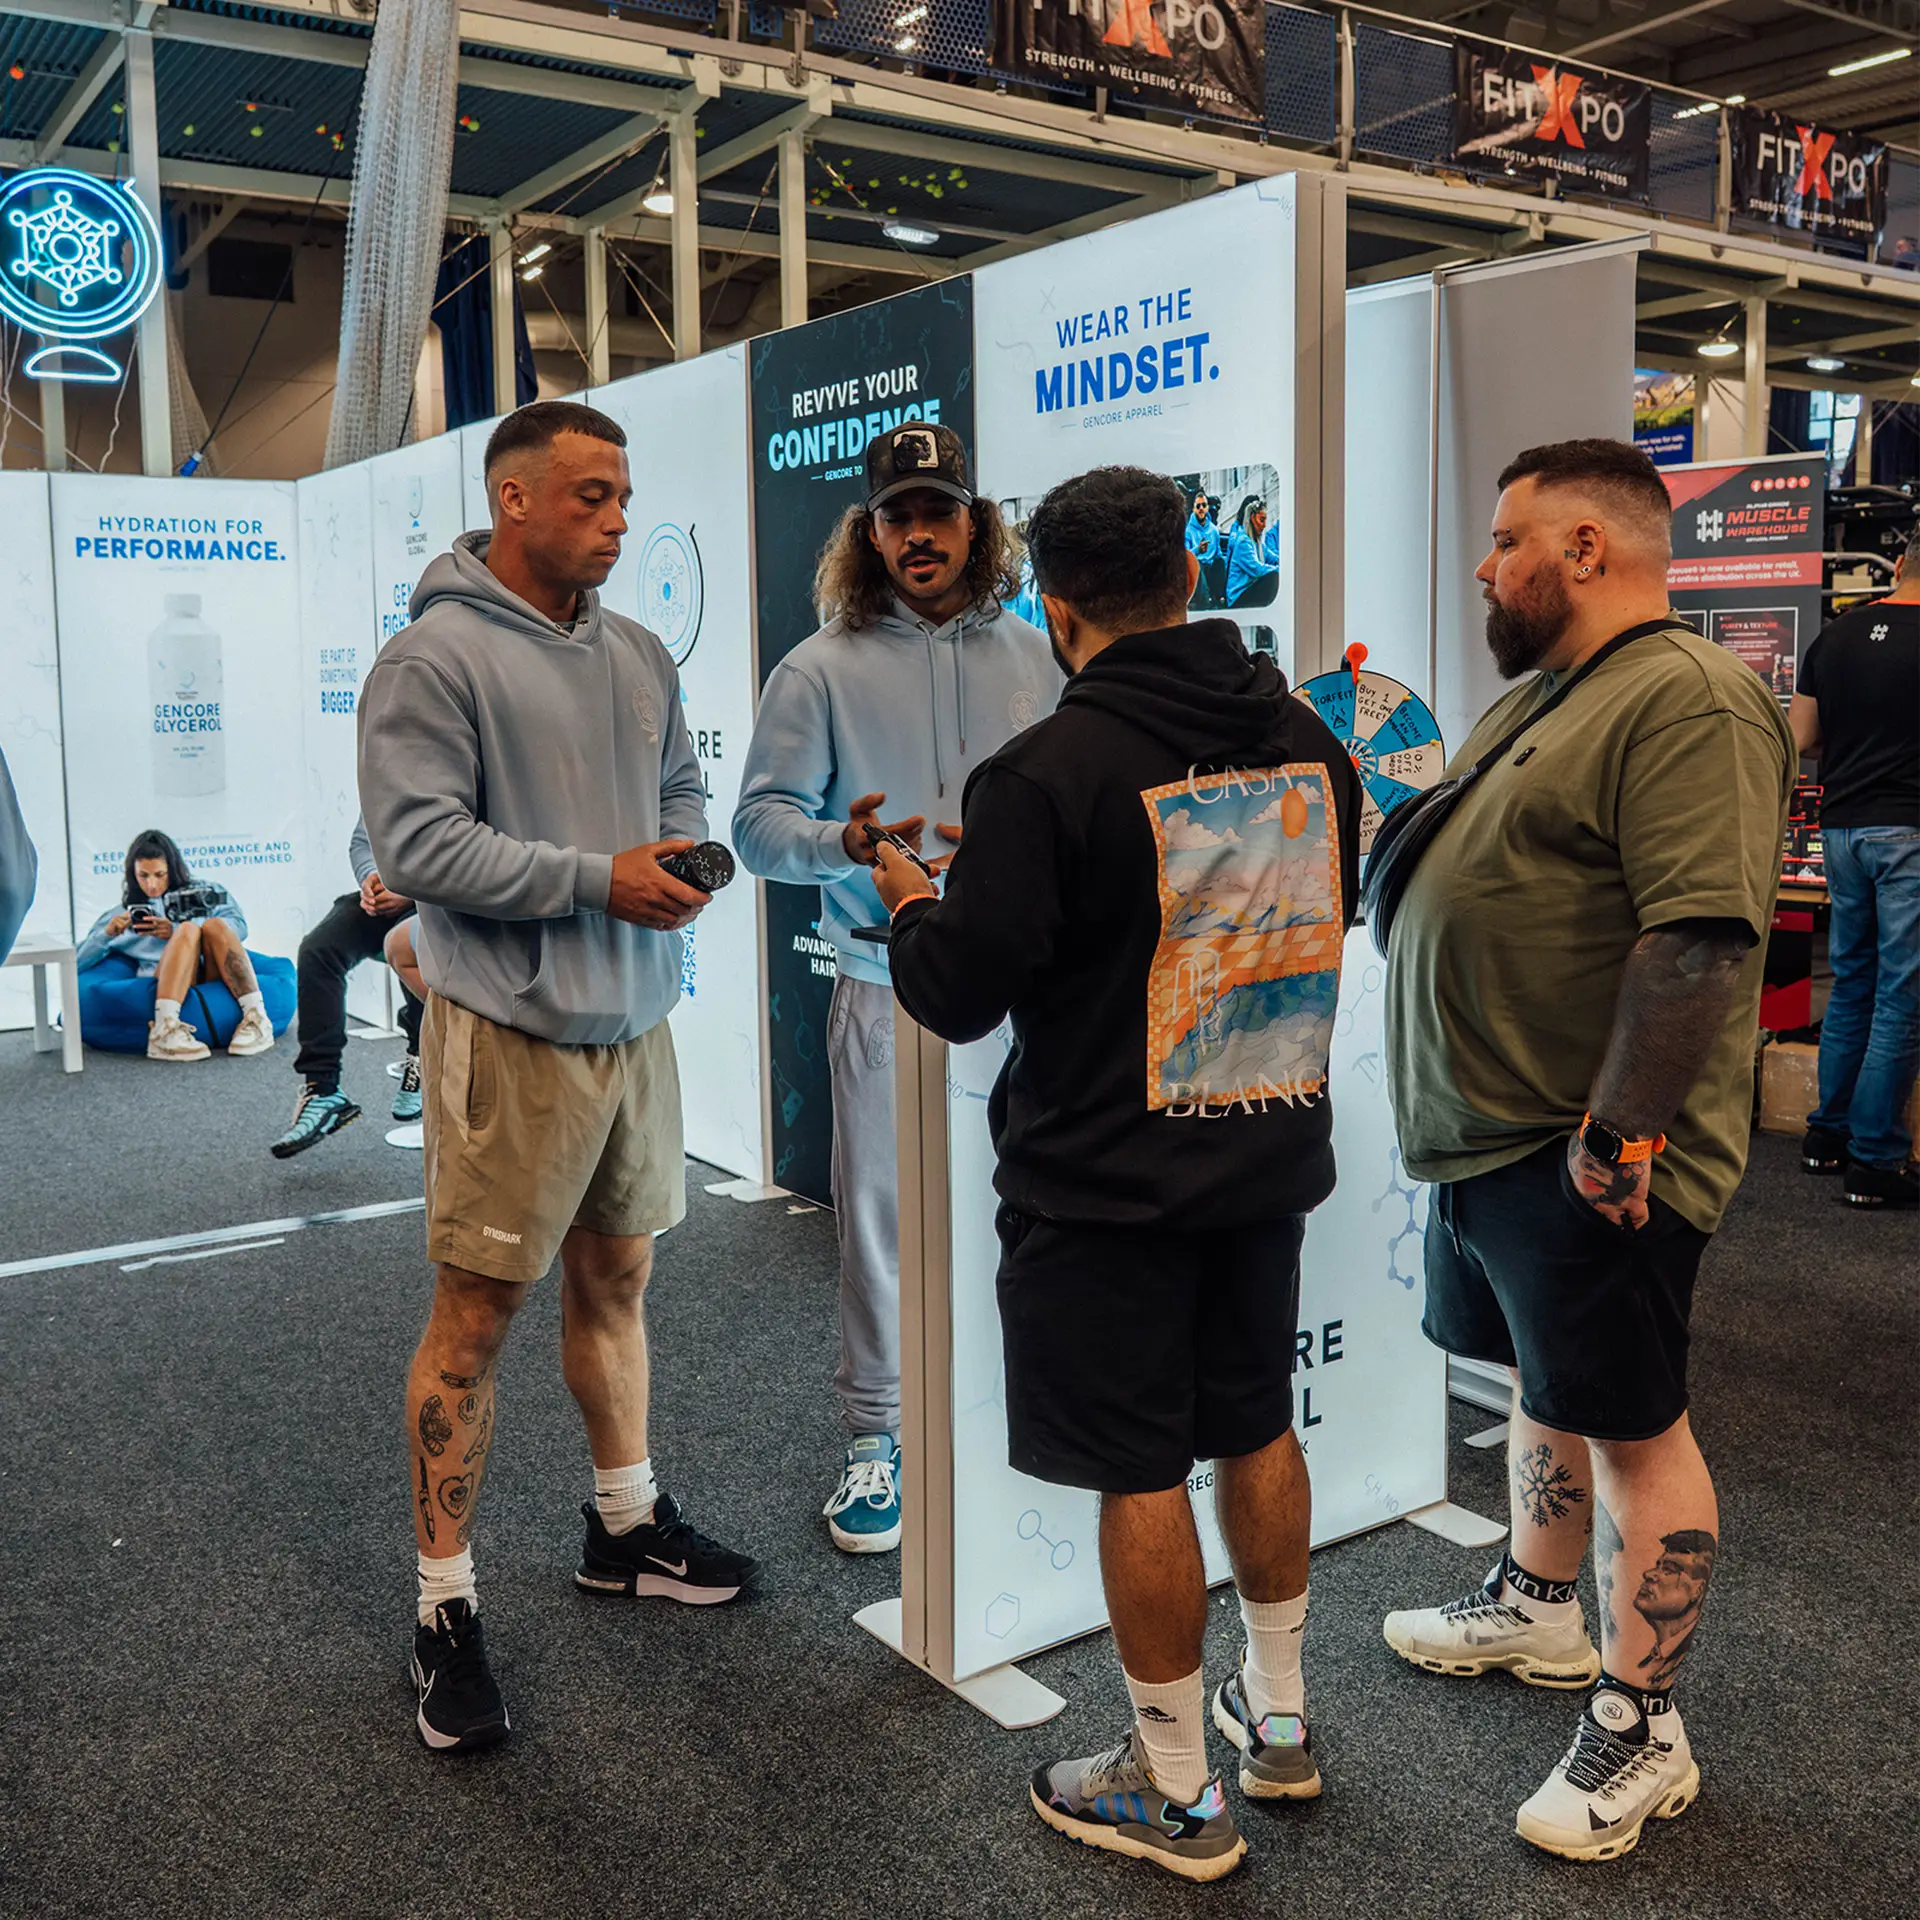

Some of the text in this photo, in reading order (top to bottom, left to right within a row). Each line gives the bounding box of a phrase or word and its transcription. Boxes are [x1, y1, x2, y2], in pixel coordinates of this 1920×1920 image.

[1034, 0, 1225, 58] XPO
[1025, 48, 1234, 104] STRENGTH WELLBEING FITNESS
[1479, 145, 1628, 187] STRENGTH WELLBEING FITNESS
[1757, 124, 1866, 201] FITXPO
[1794, 206, 1836, 225] ELLBEING
[1056, 287, 1192, 349] WEAR THE
[1035, 331, 1220, 414] MINDSET.
[792, 364, 918, 418] REVYVE YOUR
[1082, 404, 1164, 429] GENCORE APPAREL
[824, 467, 853, 482] GENCORE
[99, 516, 263, 535] HYDRATION FOR
[1726, 506, 1811, 525] MUSCLE
[1725, 523, 1808, 537] WAREHOUSE
[75, 536, 287, 561] PERFORMANCE.
[330, 648, 345, 662] PART
[347, 647, 356, 662] OF
[320, 668, 357, 683] SOMETHING
[1314, 688, 1354, 706] FORFEIT
[1359, 684, 1390, 703] BUY 1
[154, 703, 220, 718] GENCORE
[1358, 697, 1393, 714] GET ONE
[1359, 707, 1387, 722] FREE!
[153, 718, 222, 733] GLYCEROL
[1399, 706, 1422, 739] BECOME
[1399, 722, 1410, 734] AN
[1403, 753, 1412, 773] OFF
[1188, 763, 1293, 804] CASA
[93, 841, 291, 862] KEEP RFORMANCE AND
[793, 934, 836, 958] ADVANC
[811, 957, 837, 978] HAIR
[482, 1225, 522, 1245] GYMSHARK
